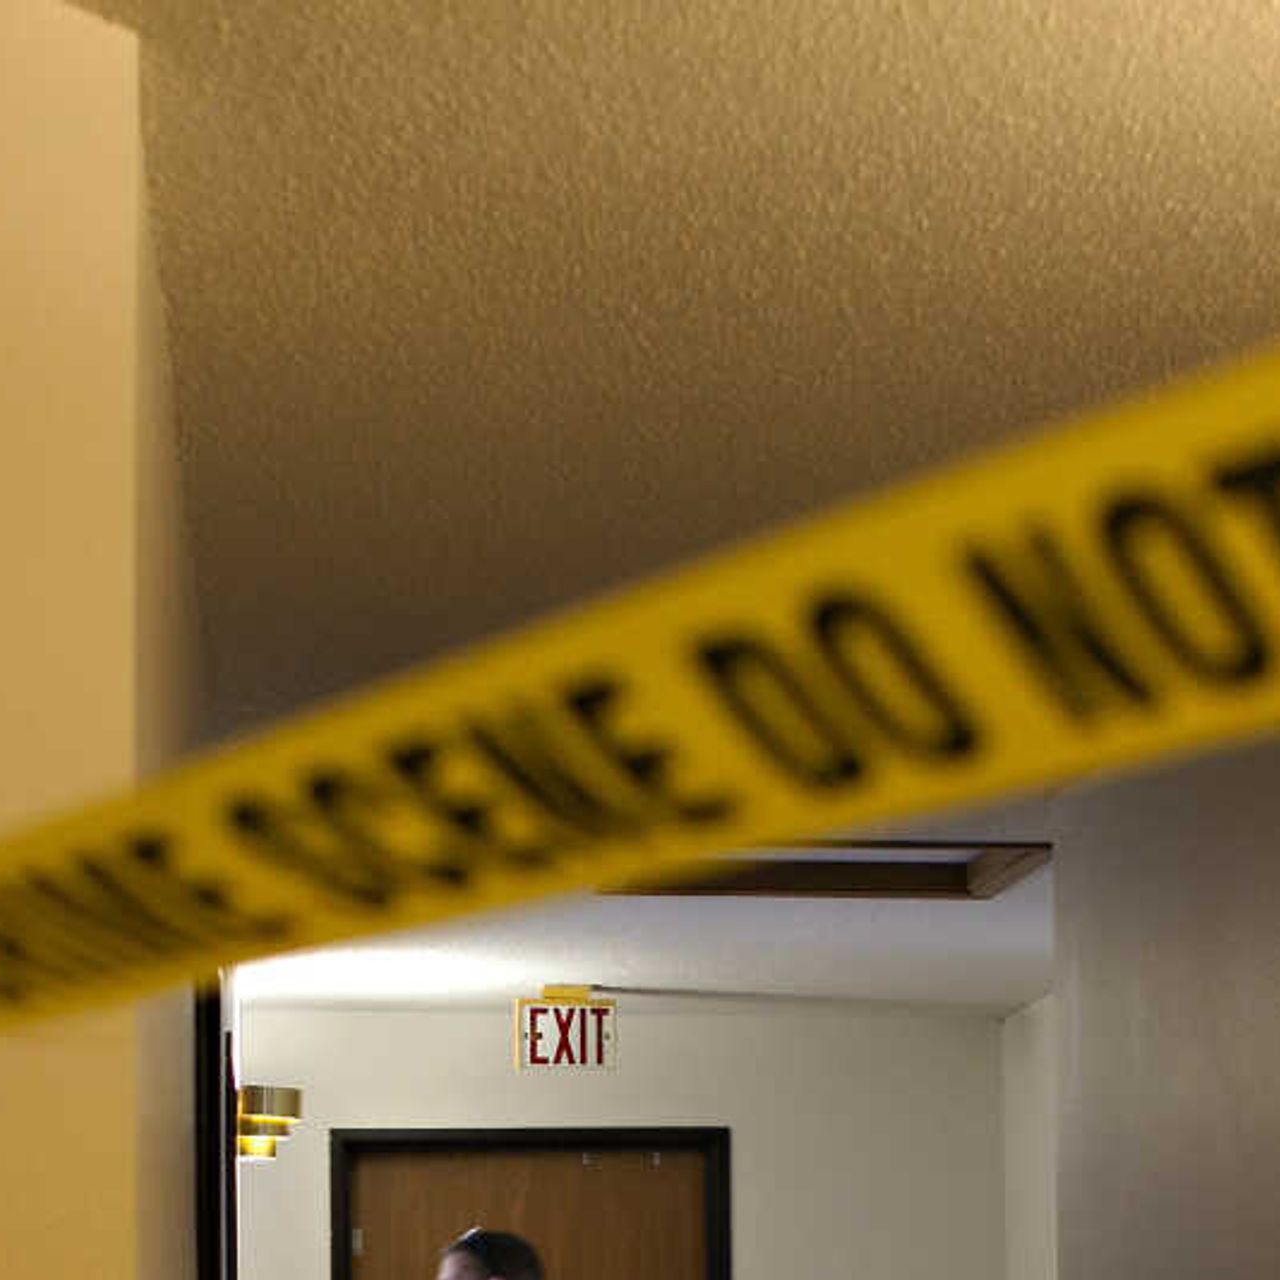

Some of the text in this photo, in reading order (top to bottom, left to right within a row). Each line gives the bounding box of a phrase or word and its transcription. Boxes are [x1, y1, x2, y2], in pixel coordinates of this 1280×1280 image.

[228, 670, 734, 914] SCENE
[694, 582, 982, 792] DO
[528, 1006, 610, 1065] EXIT
